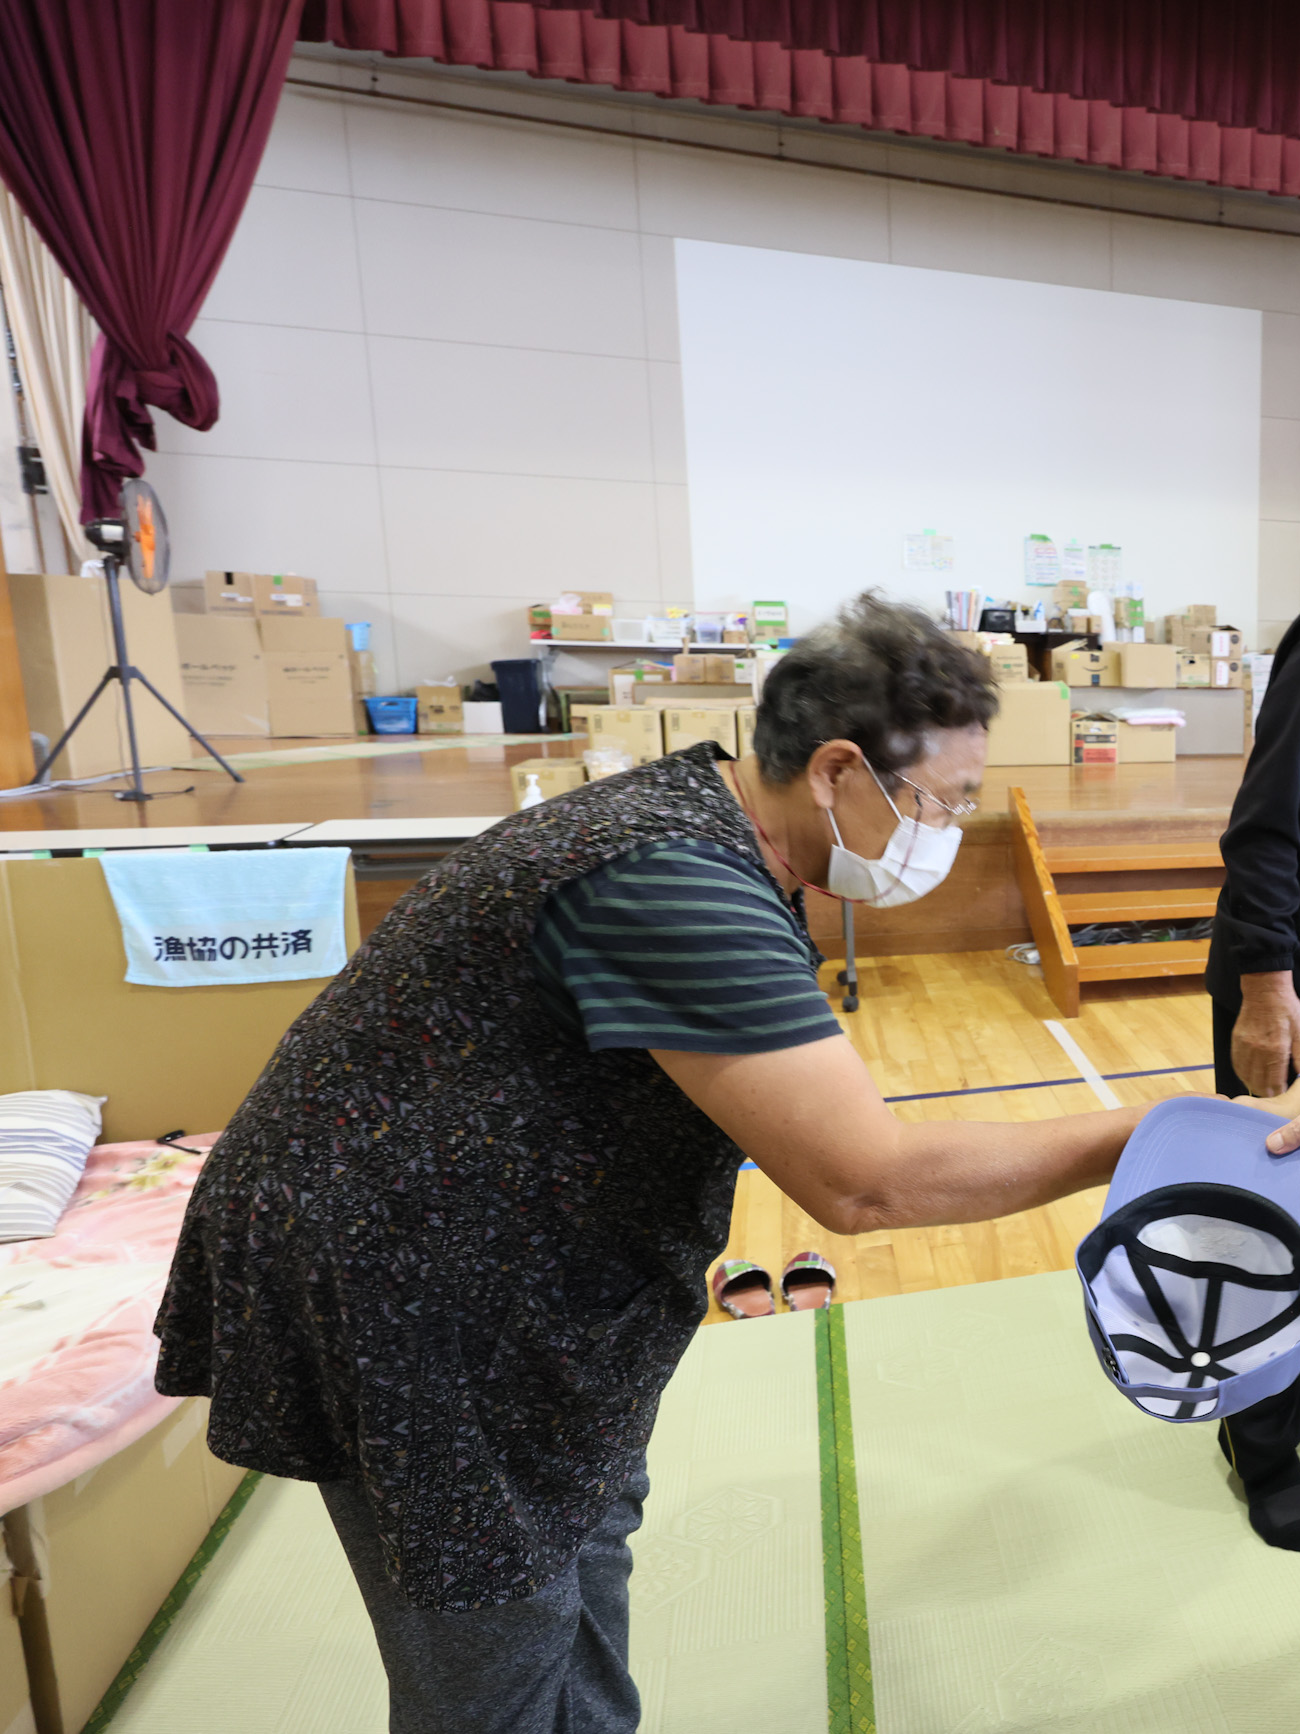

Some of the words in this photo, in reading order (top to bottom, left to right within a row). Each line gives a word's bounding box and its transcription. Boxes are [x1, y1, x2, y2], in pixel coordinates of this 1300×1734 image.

[153, 929, 313, 962] 漁協の共済
